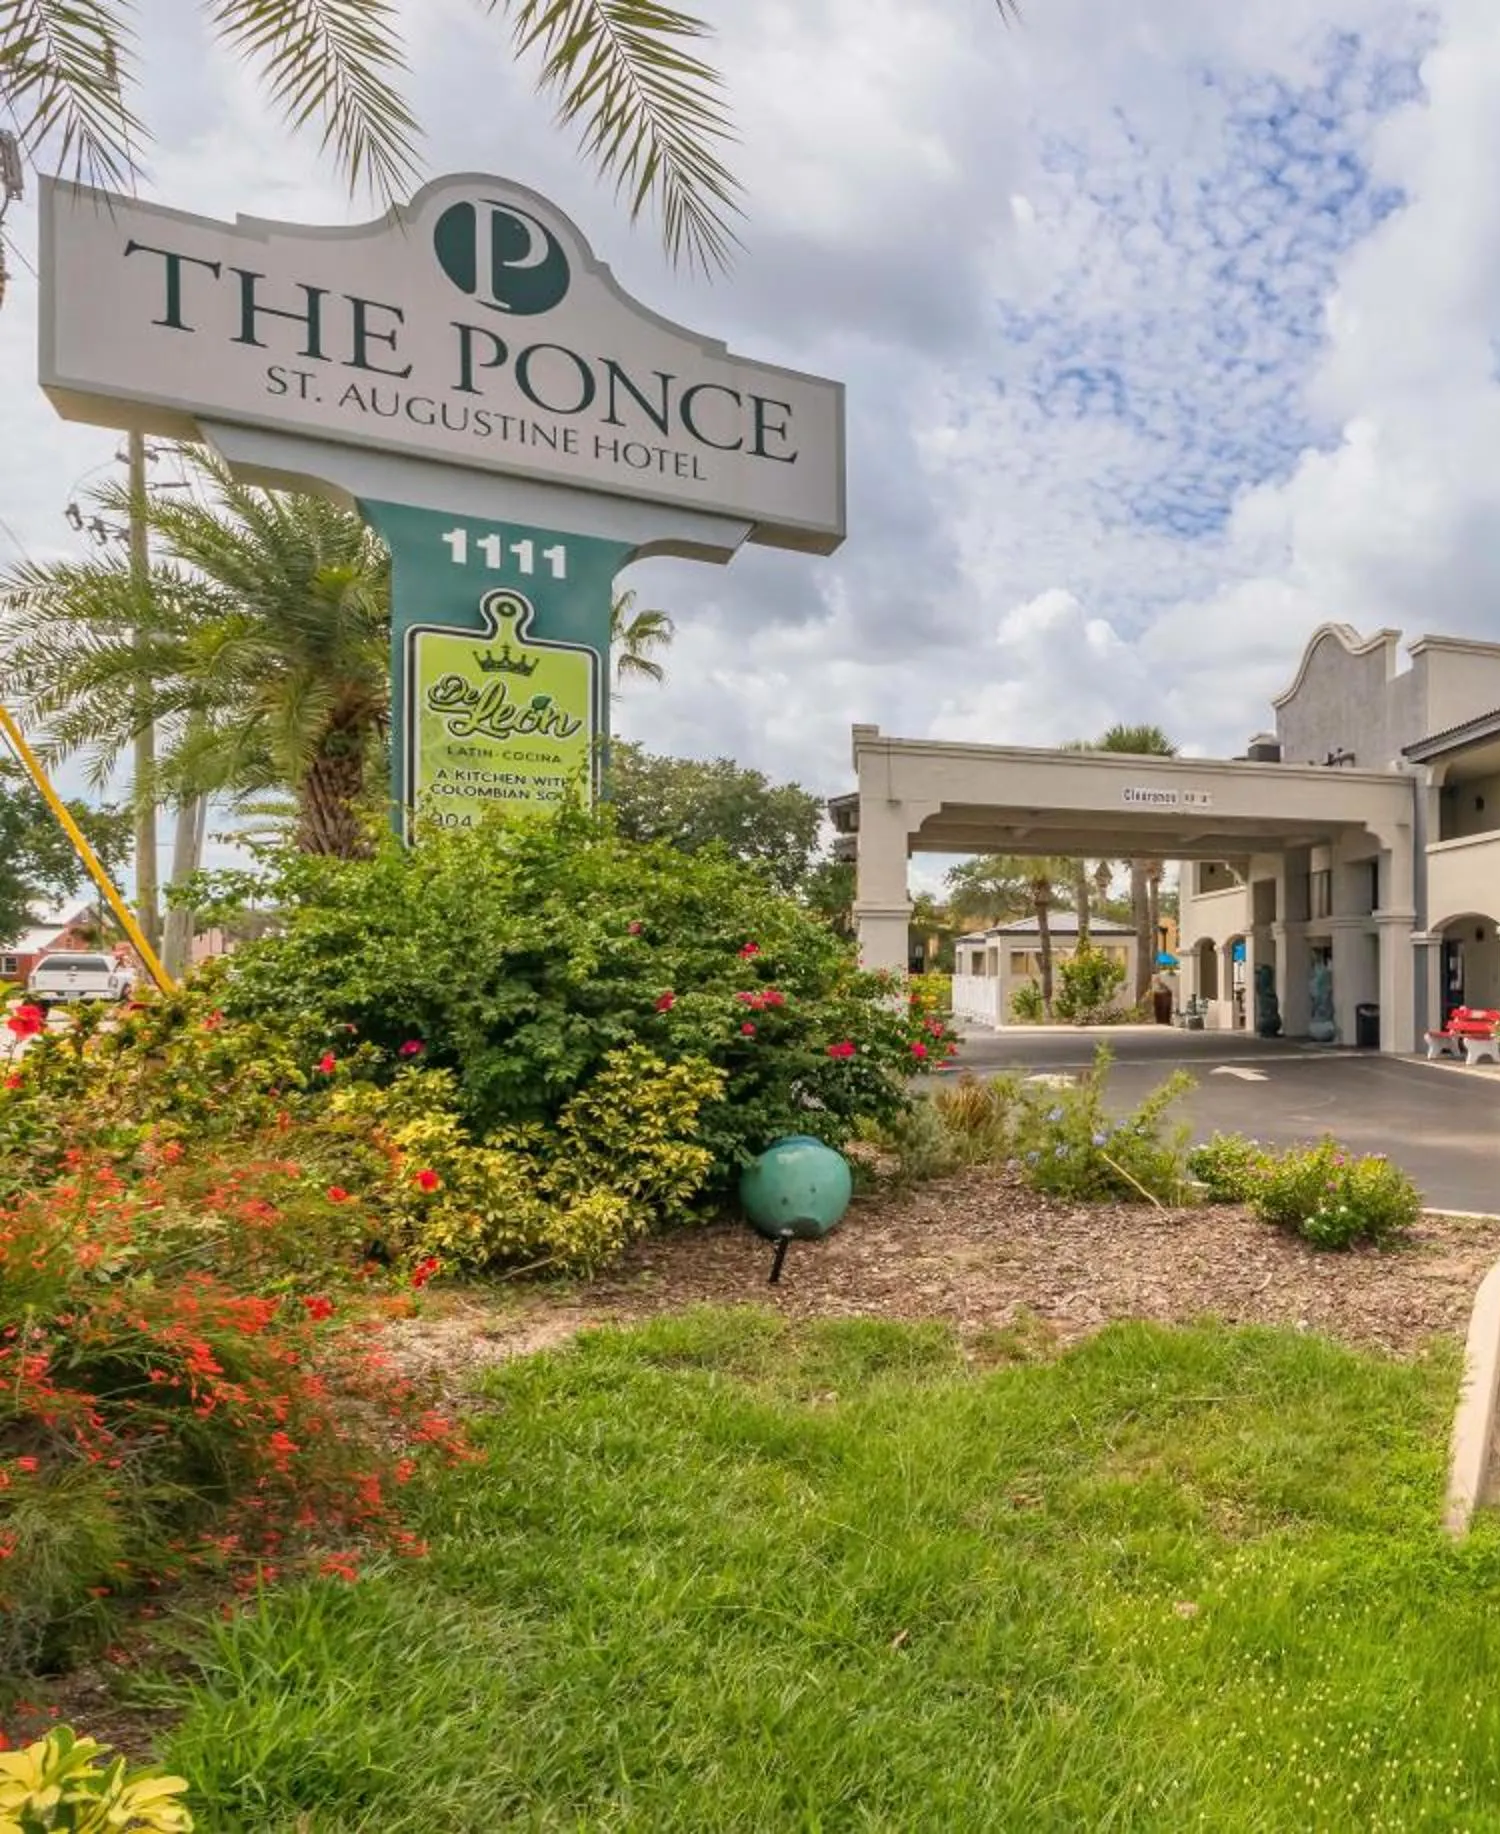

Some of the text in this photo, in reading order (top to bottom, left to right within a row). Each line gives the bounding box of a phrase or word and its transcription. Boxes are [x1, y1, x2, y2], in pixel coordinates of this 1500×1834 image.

[124, 239, 800, 464] THE PONCE
[266, 366, 708, 482] ST. AUGUSTINE HOTEL
[441, 527, 568, 580] 1111
[428, 675, 479, 706] De
[430, 784, 530, 800] COLOMBIAN
[437, 769, 448, 780] A
[455, 770, 527, 786] KITCHEN
